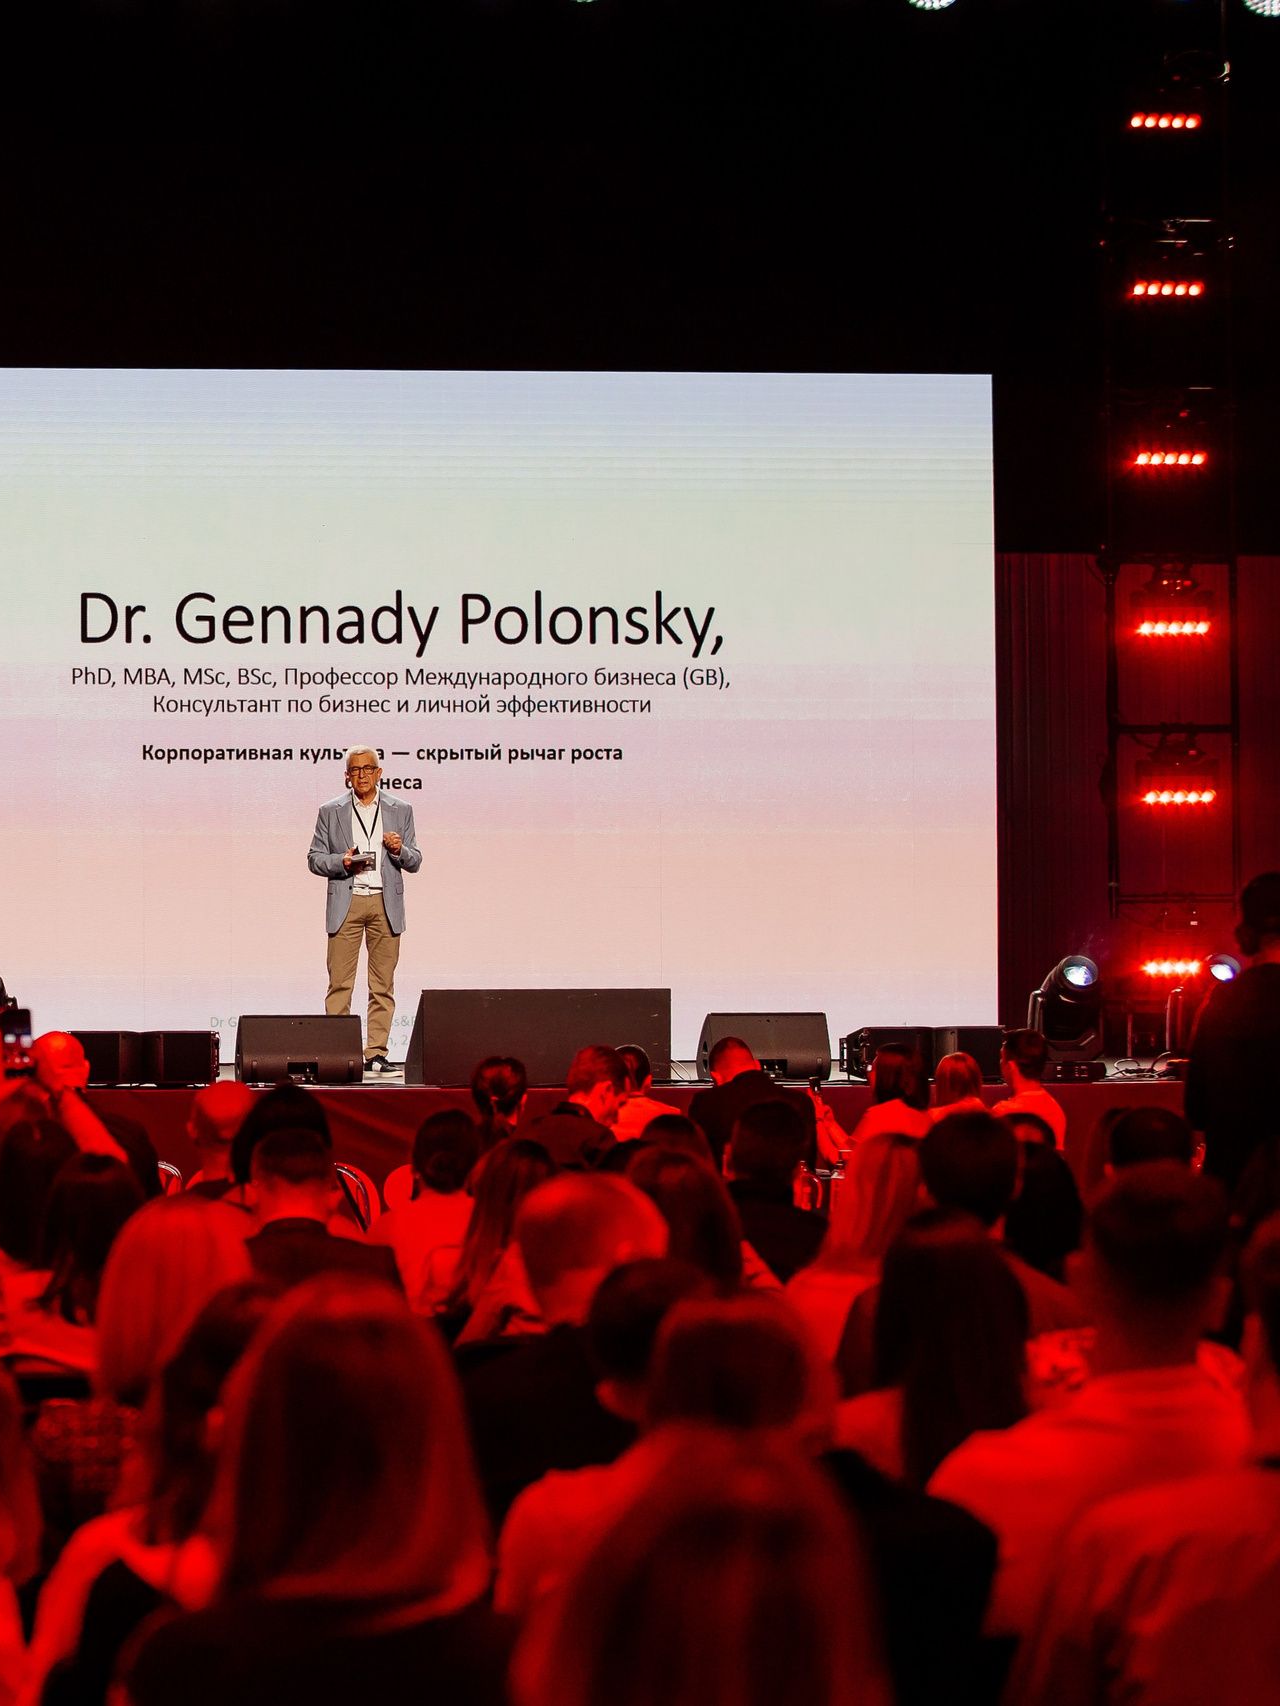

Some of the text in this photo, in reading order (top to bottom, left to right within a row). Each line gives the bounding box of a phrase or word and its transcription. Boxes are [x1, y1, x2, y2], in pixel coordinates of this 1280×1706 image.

[80, 589, 724, 659] Dr. Gennady Polonsky,
[71, 666, 731, 691] PhD, MBA, MSc, BSc, Профессор Международного бизнеса (GB),
[153, 693, 651, 718] Консультант по бизнес и личной эффективности
[142, 744, 294, 765] Корпоративная
[416, 743, 502, 765] скрытый
[507, 748, 566, 765] рычаг
[570, 747, 623, 765] роста
[209, 1015, 225, 1029] Dr
